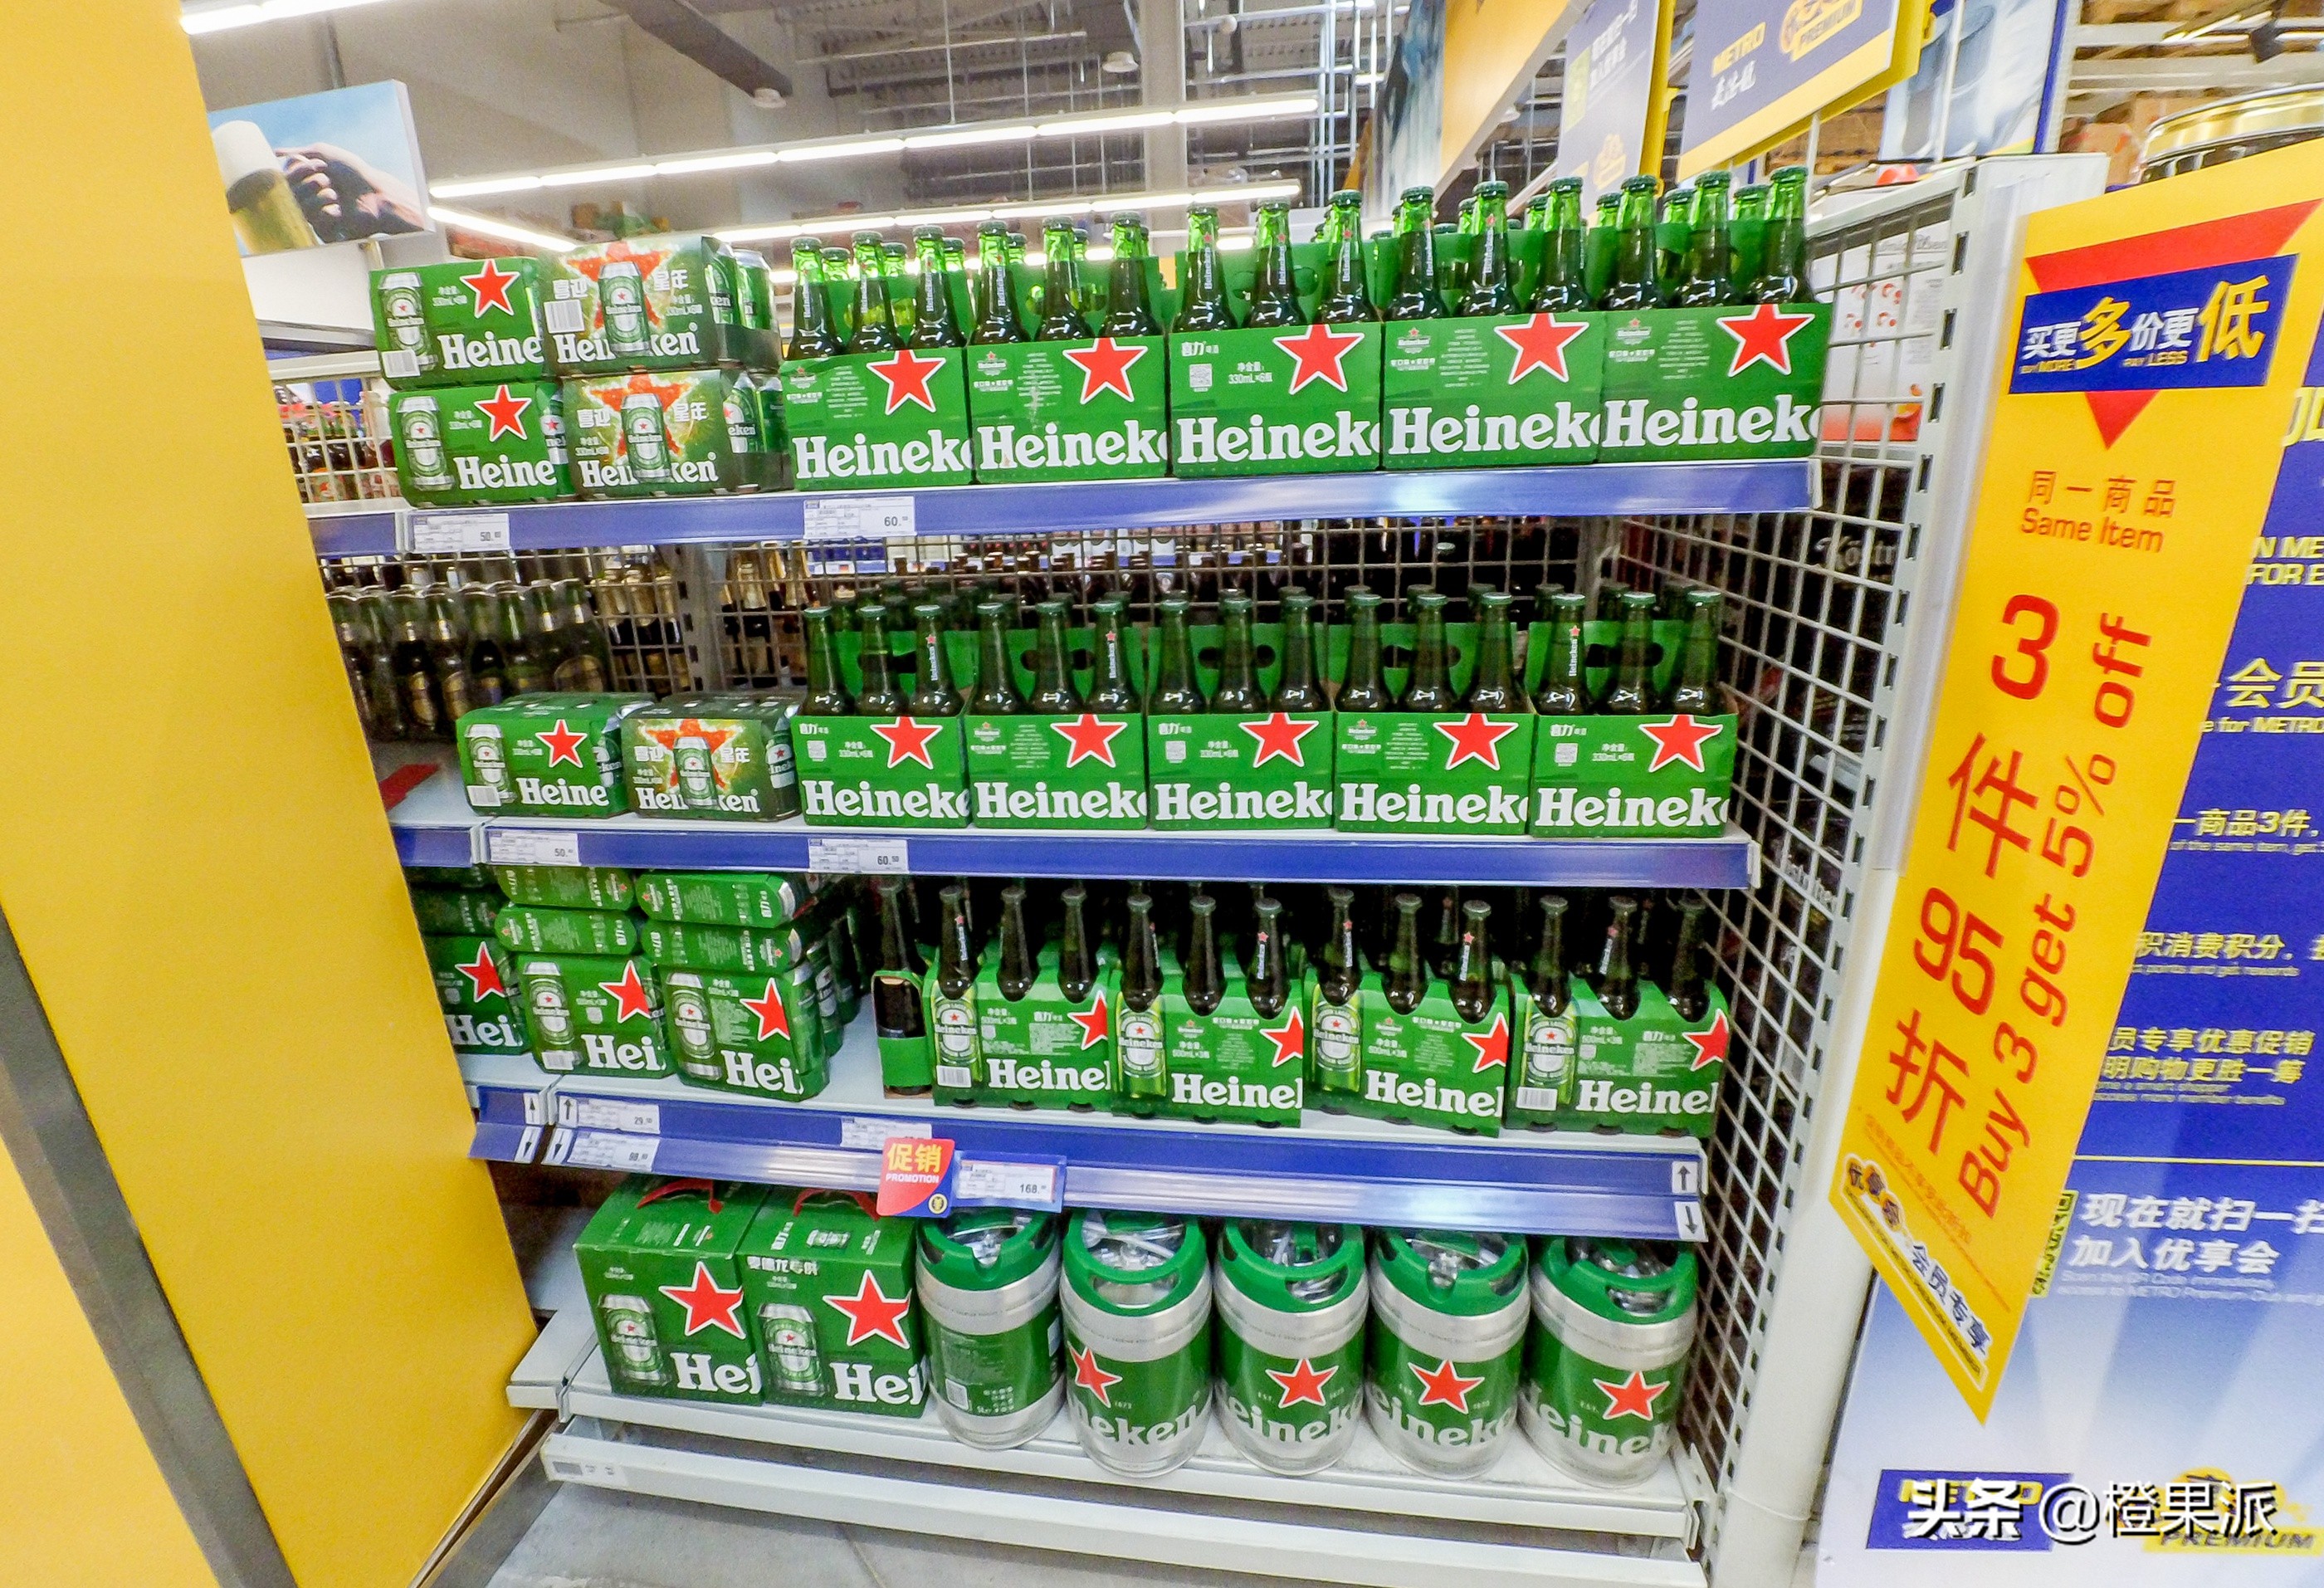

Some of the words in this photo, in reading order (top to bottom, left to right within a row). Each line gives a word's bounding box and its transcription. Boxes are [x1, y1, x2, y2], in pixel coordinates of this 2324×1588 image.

[437, 330, 544, 369] Heine
[453, 454, 557, 489] Heine
[2028, 470, 2177, 517] 同一商品
[2020, 508, 2093, 542] Same
[2098, 515, 2165, 553] Item
[2247, 563, 2305, 585] FOR
[2093, 612, 2153, 730] off
[516, 777, 609, 807] Heine
[2040, 753, 2118, 879] 5%
[2020, 894, 2078, 1028] get
[446, 1010, 521, 1047] Hei
[581, 1034, 666, 1071] Hei
[720, 1049, 803, 1095] Hei
[1994, 1021, 2039, 1084] 3
[887, 1143, 942, 1173] 促销
[1956, 1087, 2032, 1220] Buy
[886, 1173, 940, 1184] PROMOTION
[2069, 1234, 2281, 1274] 加入优享会
